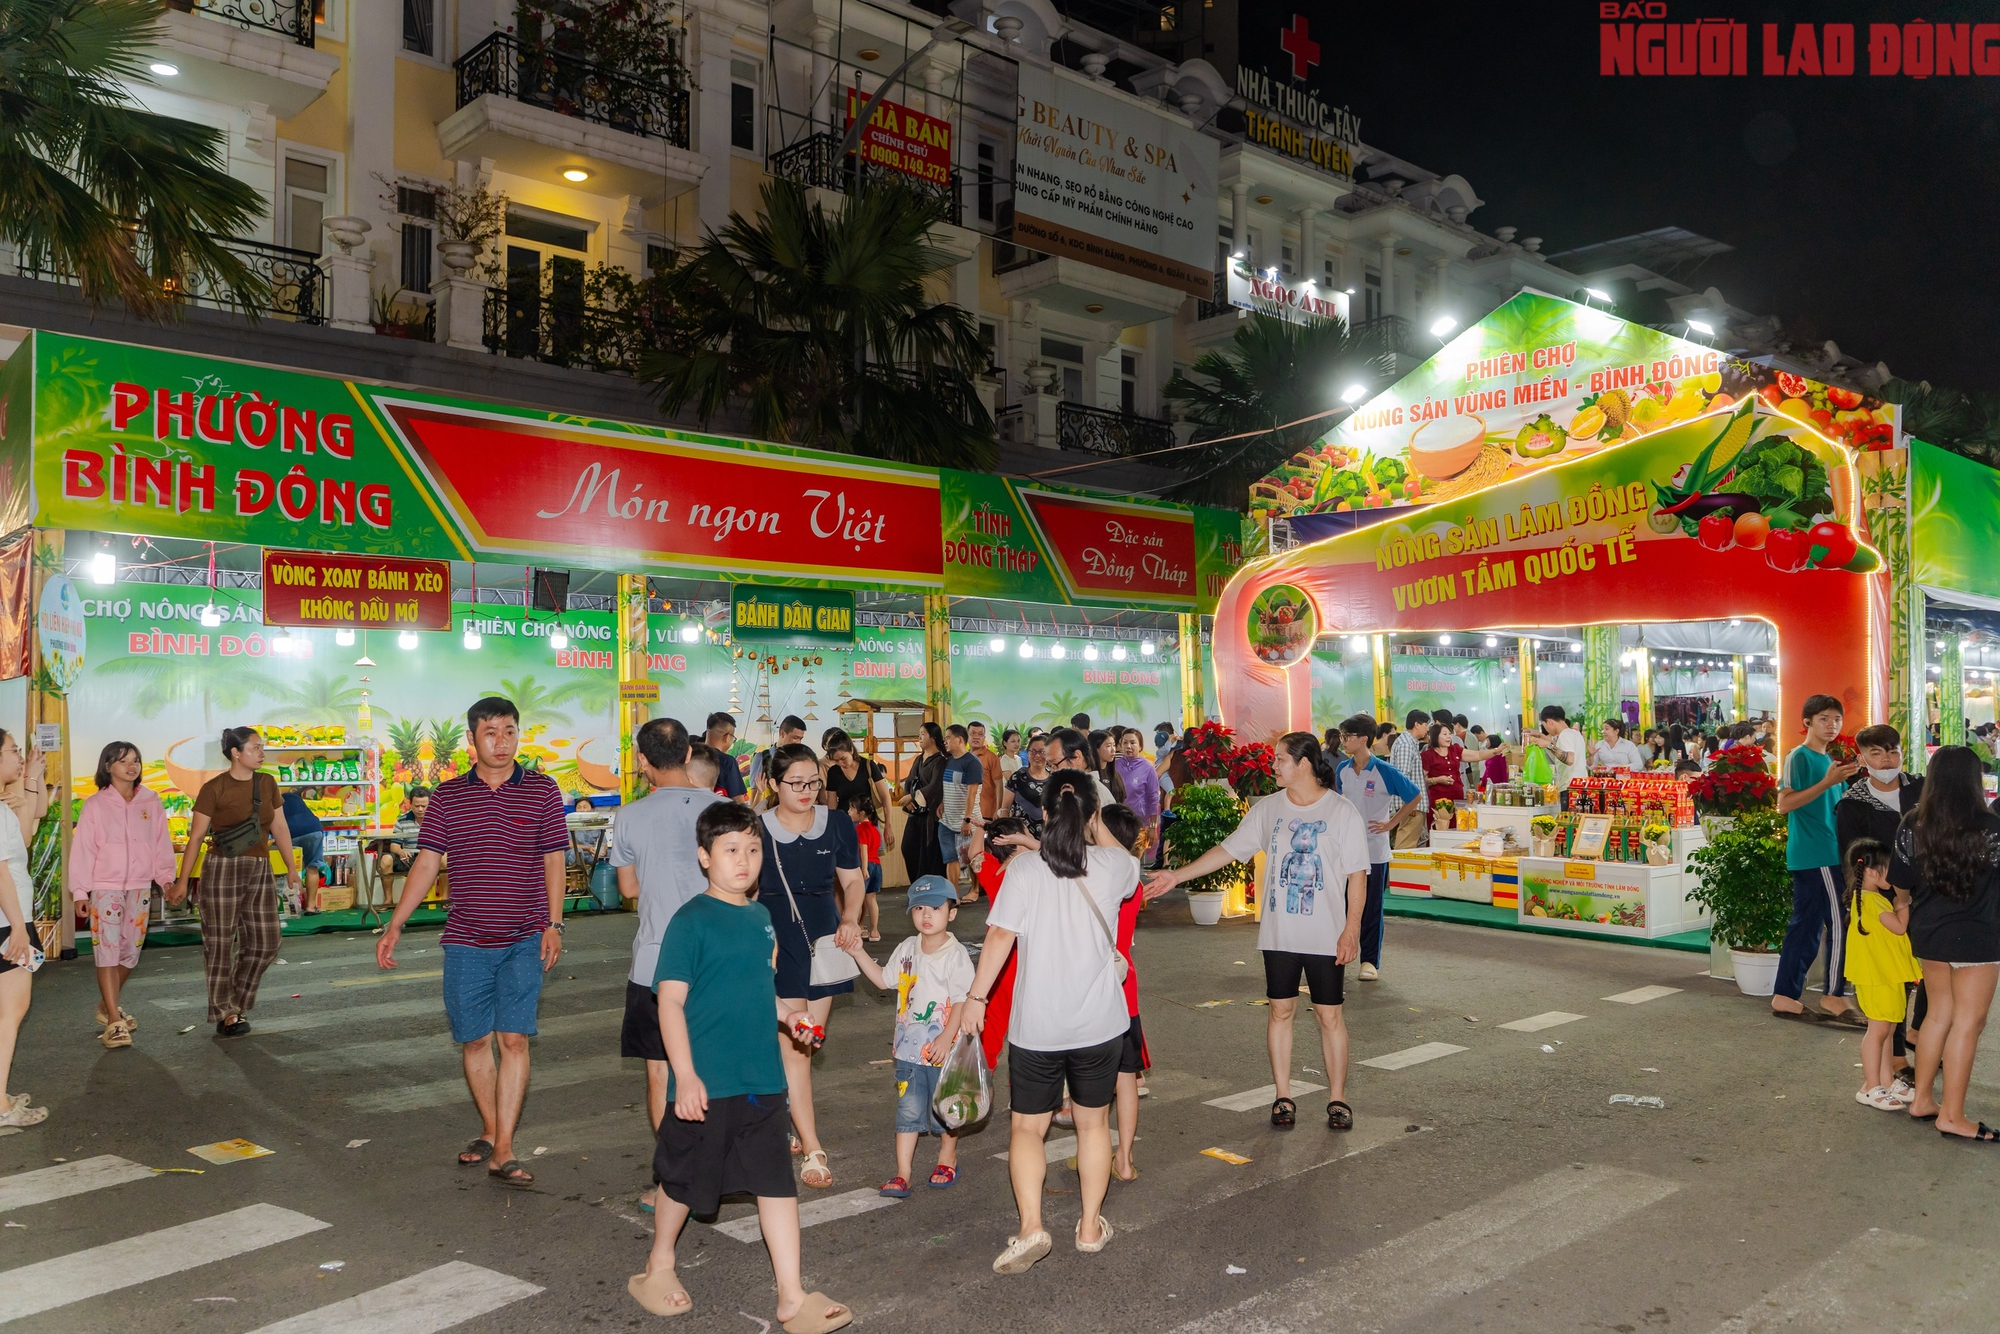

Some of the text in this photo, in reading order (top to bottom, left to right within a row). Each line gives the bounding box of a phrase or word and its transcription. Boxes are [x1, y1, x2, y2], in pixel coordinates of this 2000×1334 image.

[1237, 64, 1361, 147] NHÀ THUỐC TÂY
[871, 131, 928, 158] CHÍNH CHỦ
[905, 115, 949, 151] BÁN
[1032, 100, 1119, 151] BEAUTY
[1124, 136, 1139, 159] &
[1144, 143, 1178, 174] SPA
[1245, 109, 1351, 176] THANH UYÊN
[870, 144, 947, 183] 0909.149.373
[1043, 135, 1076, 161] Nguồn
[1078, 148, 1097, 168] Của
[1099, 155, 1126, 178] Nhan
[1127, 166, 1146, 185] Sắc
[1027, 166, 1063, 190] NHANG,
[1065, 180, 1082, 194] SẸO
[1099, 187, 1123, 207] BẰNG
[1125, 199, 1151, 217] CÔNG
[1152, 209, 1175, 227] NGHỆ
[1176, 217, 1194, 231] CAO
[1041, 187, 1060, 203] CẤP
[1078, 200, 1103, 218] PHẨM
[1105, 209, 1132, 228] CHÍNH
[1018, 221, 1046, 239] ĐƯỜNG
[1069, 238, 1085, 250] KDC
[1248, 278, 1298, 310] NGỌC
[1300, 290, 1336, 319] ÁNH
[1466, 340, 1577, 382] PHIÊN CHỢ
[1409, 396, 1448, 423] SẢN
[1454, 390, 1506, 415] VÙNG
[1513, 375, 1568, 406] MIỀN
[1590, 366, 1645, 393] BÌNH
[1651, 351, 1718, 383] ĐÔNG
[110, 381, 355, 459] PHƯỜNG
[62, 443, 216, 516] BÌNH
[233, 464, 393, 529] ĐÔNG
[537, 462, 886, 552] Món ngon Việt
[972, 501, 1011, 538] TỈNH
[1374, 480, 1648, 572] NÔNG SẢN LÂM ĐỒNG
[944, 533, 1039, 573] ĐỒNG THÁP
[1105, 520, 1163, 548] Đặc sản
[272, 559, 443, 592] VÒNG XOAY BÁNH XÈO
[1082, 547, 1188, 588] Đồng Tháp
[1392, 522, 1637, 612] VƯƠN TẦM QUỐC TẾ
[81, 598, 132, 623] CHỢ
[300, 595, 419, 623] KHÔNG DẦU MỠ
[736, 596, 850, 632] BÁNH DÂN GIAN
[128, 627, 210, 655] BÌNH
[563, 620, 611, 641] NÔNG
[859, 636, 895, 653] NÔNG
[897, 637, 923, 655] SẢN
[556, 649, 613, 670] BÌNH
[853, 658, 896, 678] BÌNH
[1083, 667, 1160, 685] BÌNH ĐÔNG
[1406, 677, 1428, 692] BÌNH
